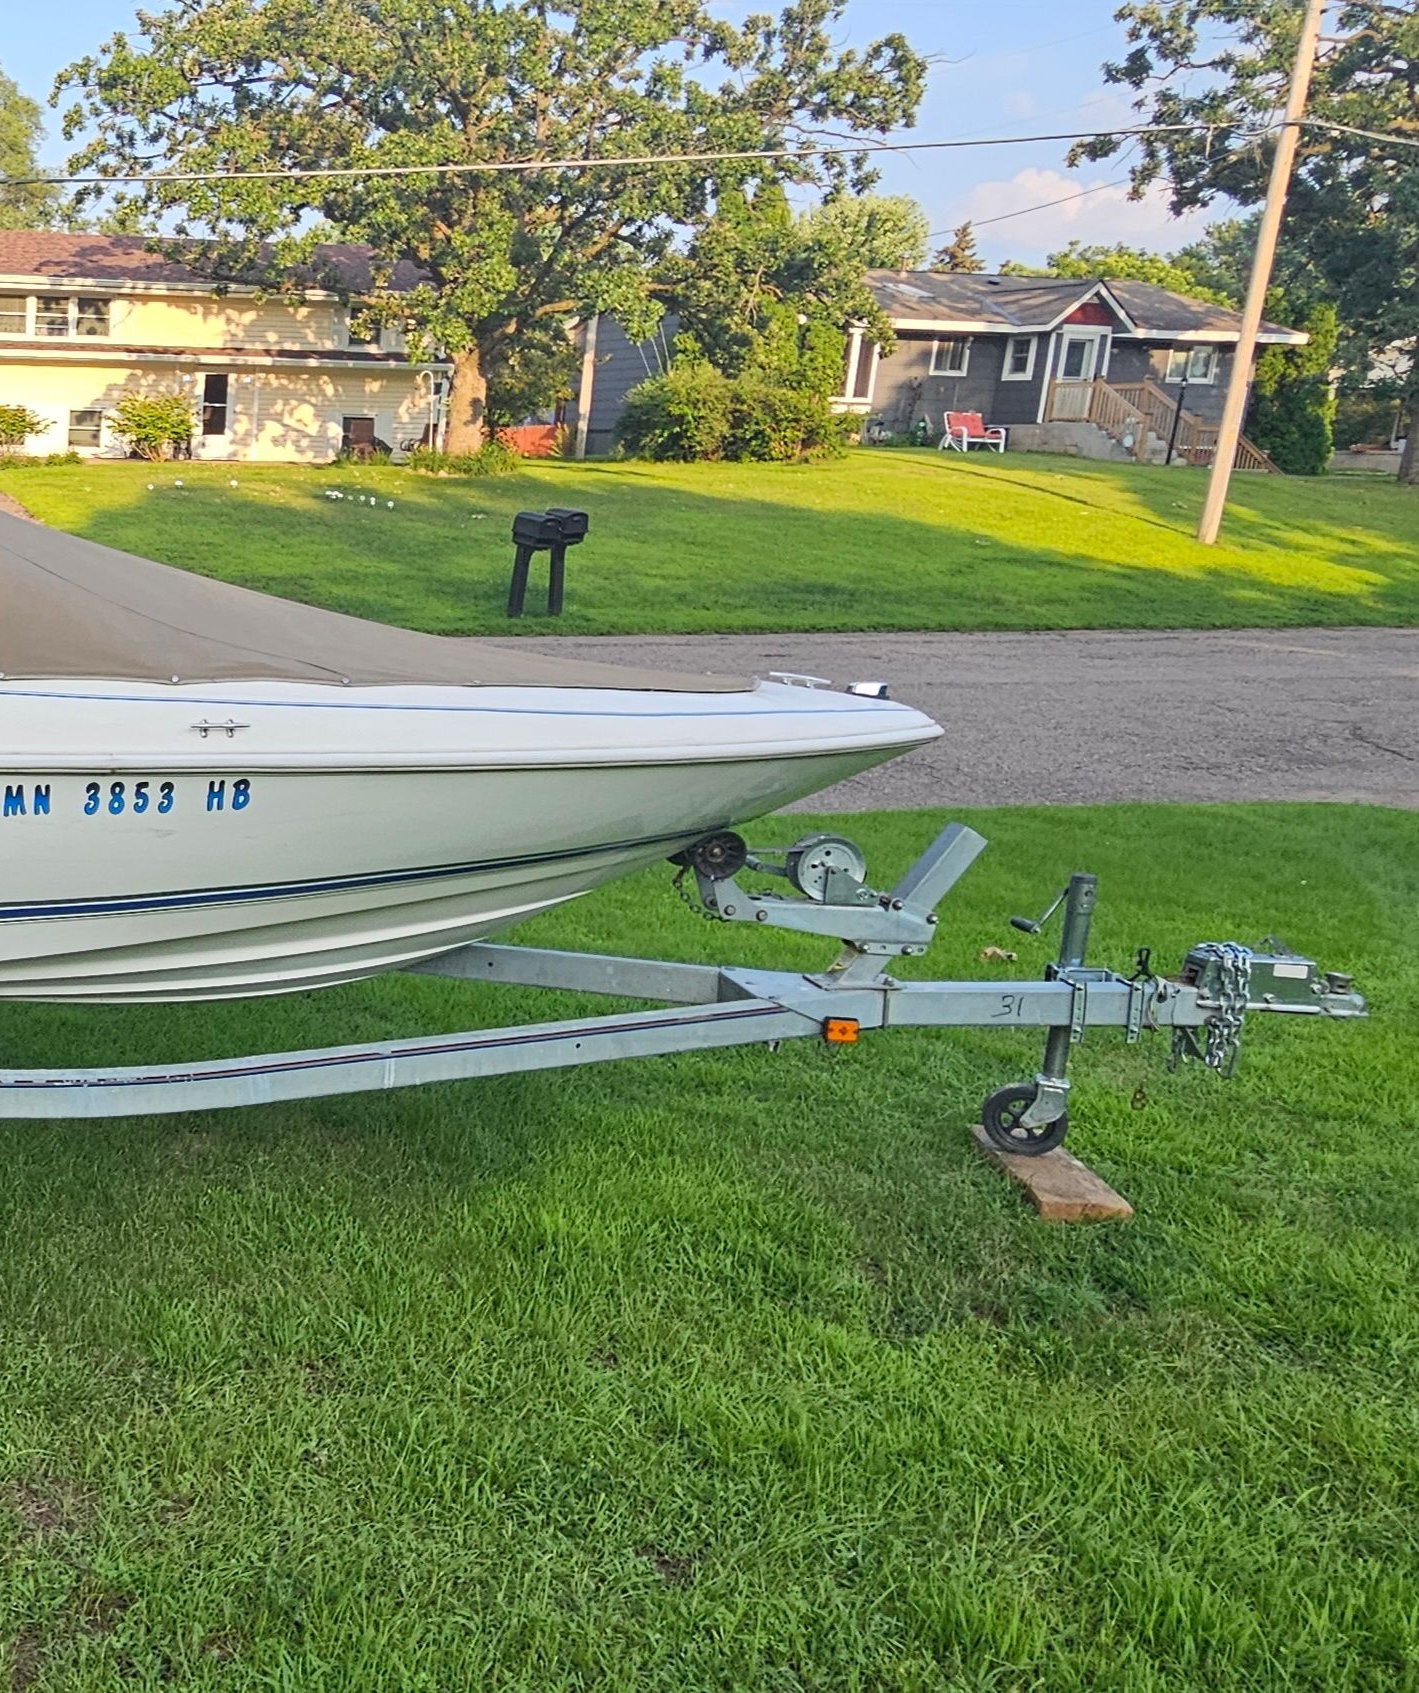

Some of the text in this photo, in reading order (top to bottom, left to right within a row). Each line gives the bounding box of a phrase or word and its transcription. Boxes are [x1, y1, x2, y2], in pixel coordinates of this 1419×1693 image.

[3, 778, 251, 817] MN 3853 HB
[991, 994, 1025, 1018] 31
